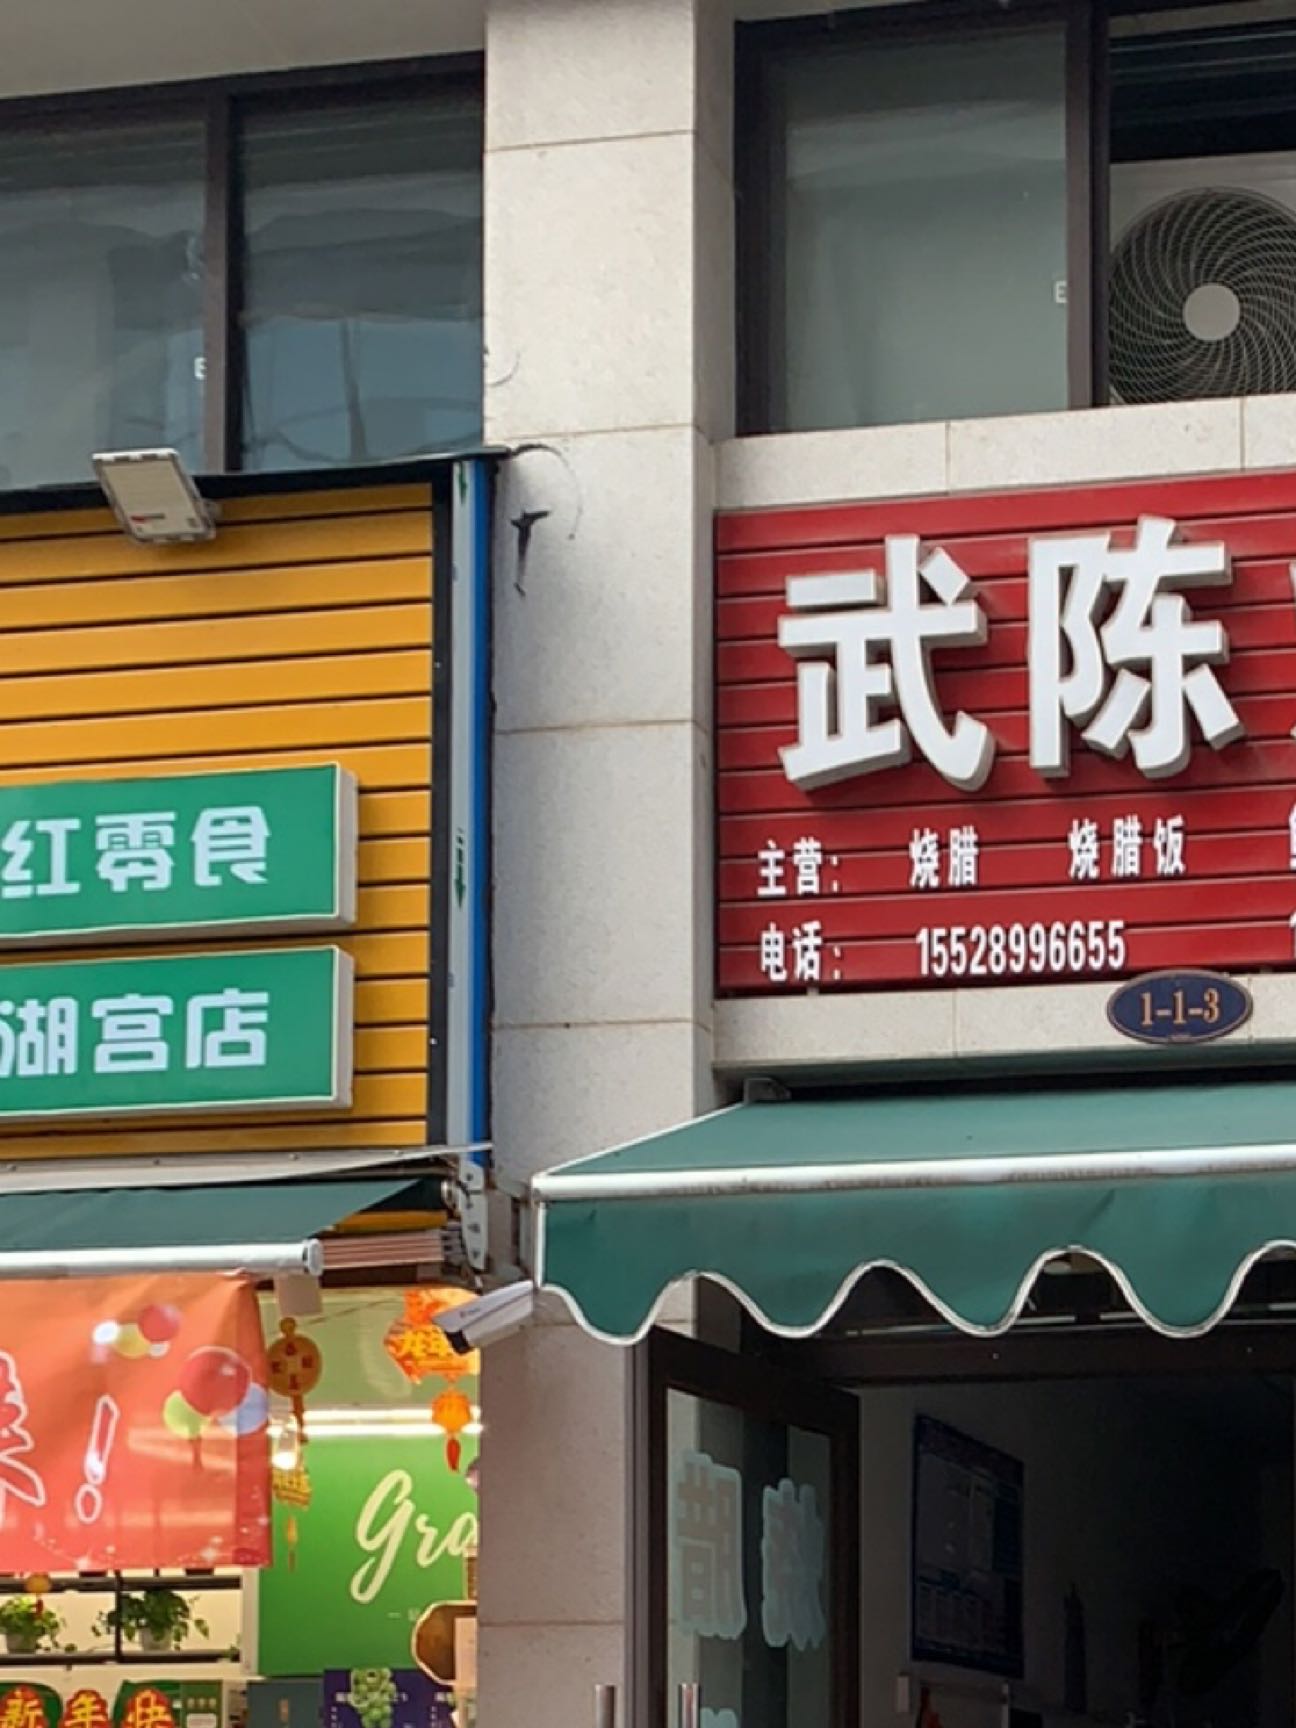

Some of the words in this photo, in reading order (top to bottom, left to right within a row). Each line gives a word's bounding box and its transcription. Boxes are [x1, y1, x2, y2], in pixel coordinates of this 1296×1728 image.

[0, 805, 271, 899] 红零食
[908, 826, 979, 888] 烧腊
[1068, 814, 1186, 880] 烧腊饭
[916, 920, 1126, 977] 15528996655
[1140, 987, 1220, 1026] 1-1-3
